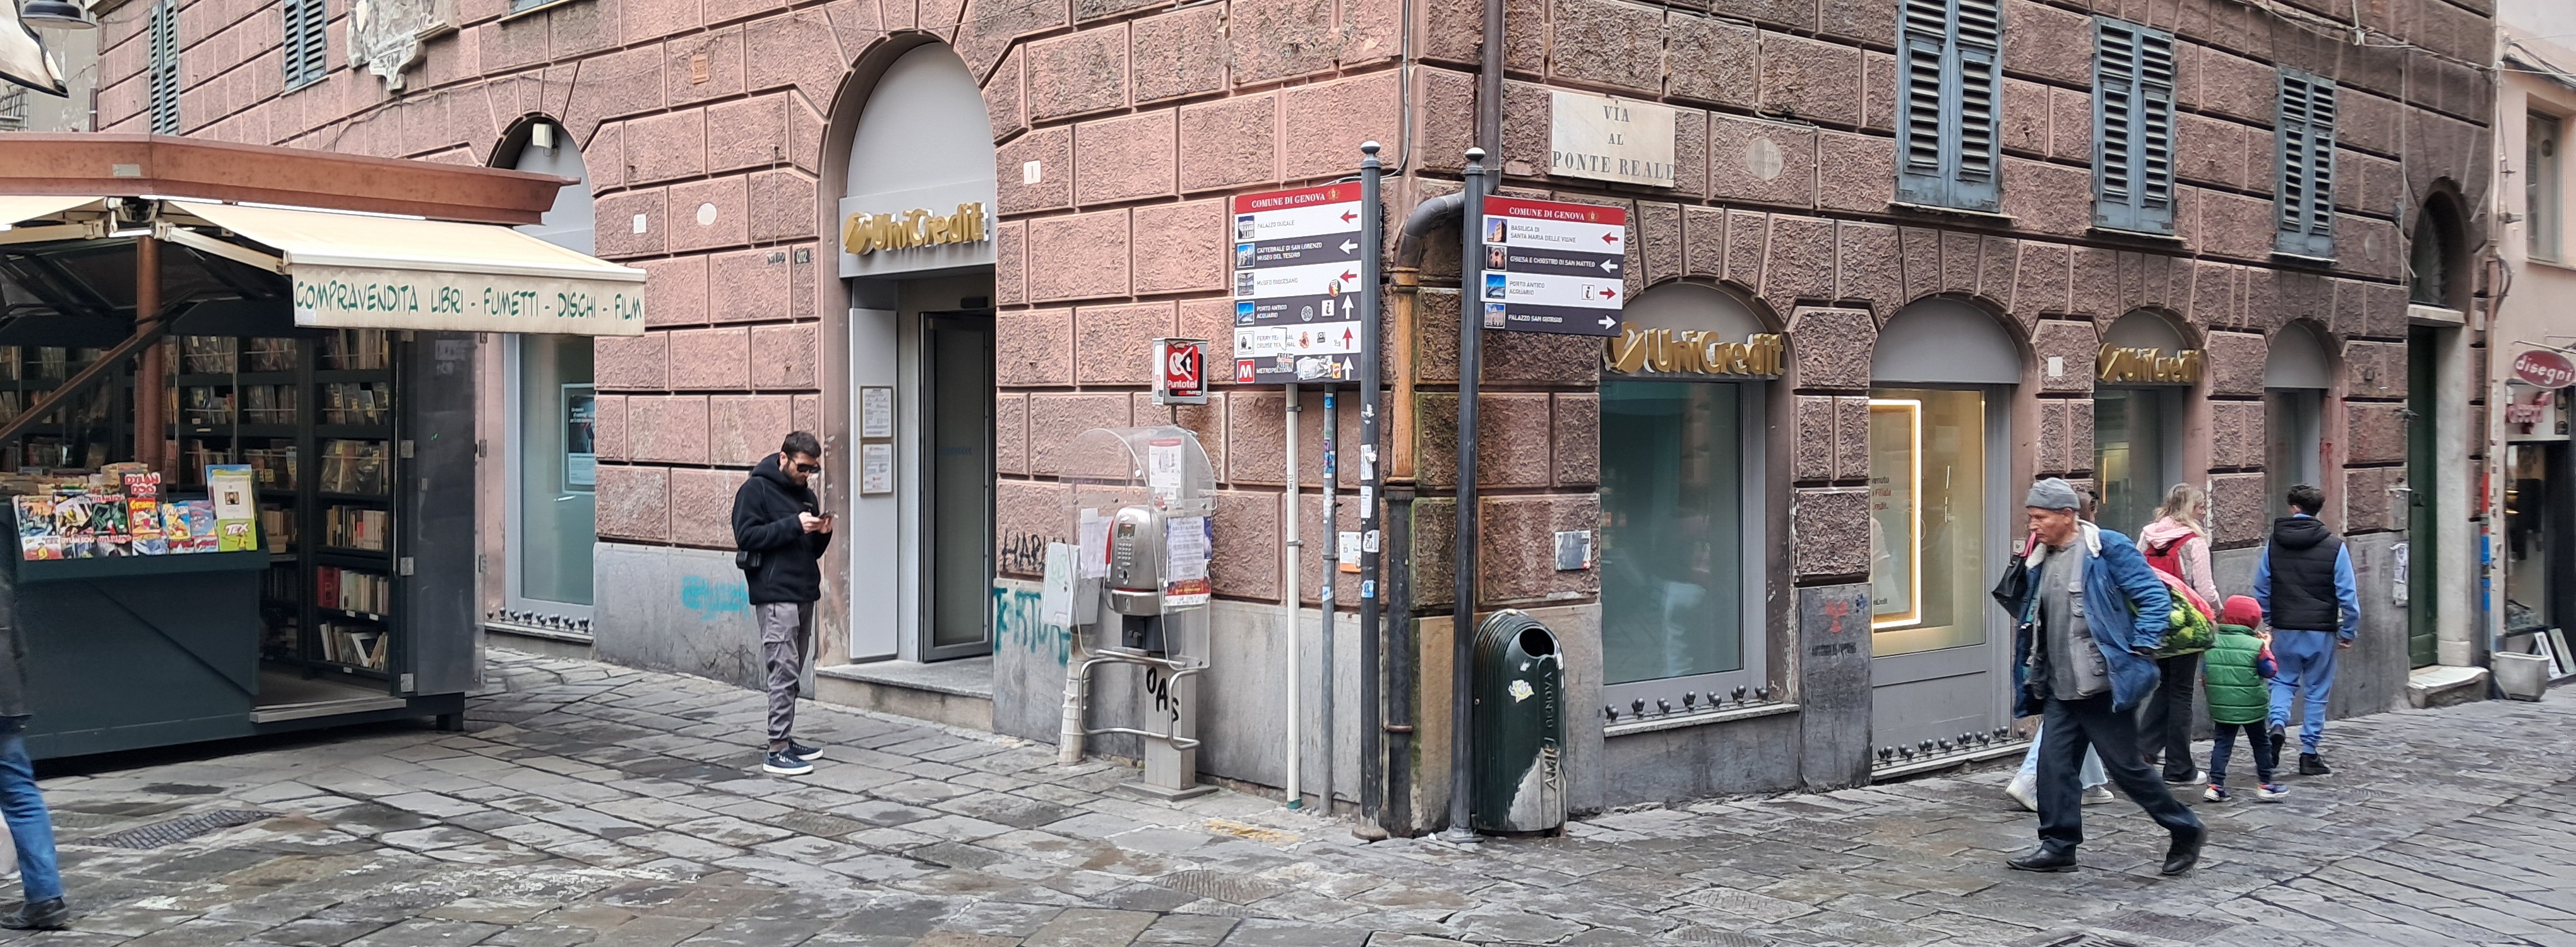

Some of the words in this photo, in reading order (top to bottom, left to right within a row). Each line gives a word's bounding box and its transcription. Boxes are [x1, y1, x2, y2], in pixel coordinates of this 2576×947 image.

[1602, 105, 1630, 123] VIA
[1607, 133, 1624, 146] AL
[1552, 150, 1611, 174] PONTE
[1618, 158, 1674, 181] REALE
[1251, 197, 1284, 209] COMUNE
[1284, 196, 1293, 205] DI
[1294, 192, 1326, 205] GENOVA
[1509, 206, 1542, 218] COMUNE
[1544, 210, 1553, 218] DI
[1554, 211, 1585, 221] GENOVA
[872, 201, 989, 251] UniCredit
[1257, 221, 1277, 229] PALAZZO
[1511, 224, 1534, 232] BASILICA
[1510, 232, 1528, 241] SANTA
[1528, 234, 1544, 242] MARIA
[1561, 235, 1577, 244] VIGNE
[1256, 246, 1285, 254] CATTEDRALE
[1301, 242, 1323, 250] LORENZO
[1283, 251, 1301, 259] TESORO
[1510, 255, 1529, 264] CHIESA
[1533, 257, 1558, 265] CHIOSTRO
[1575, 259, 1596, 268] MATTEO
[1509, 280, 1526, 289] PORTO
[1526, 281, 1545, 289] ANTICO
[1508, 288, 1535, 296] ACQUARIO
[295, 279, 419, 315] COMPRAVENDITA
[431, 285, 464, 314] LIBRI
[483, 286, 540, 318] FUMETTI
[557, 292, 597, 319] DISCHI
[614, 293, 643, 322] FILM
[1508, 314, 1530, 322] PALAZZO
[1542, 316, 1563, 324] GIORGIO
[1646, 327, 1786, 376] UniCredit
[2515, 354, 2573, 385] disegni
[1167, 379, 1198, 389] Puntotel
[124, 472, 161, 485] DYLAN
[131, 483, 157, 495] DOG
[224, 522, 250, 537] TEX
